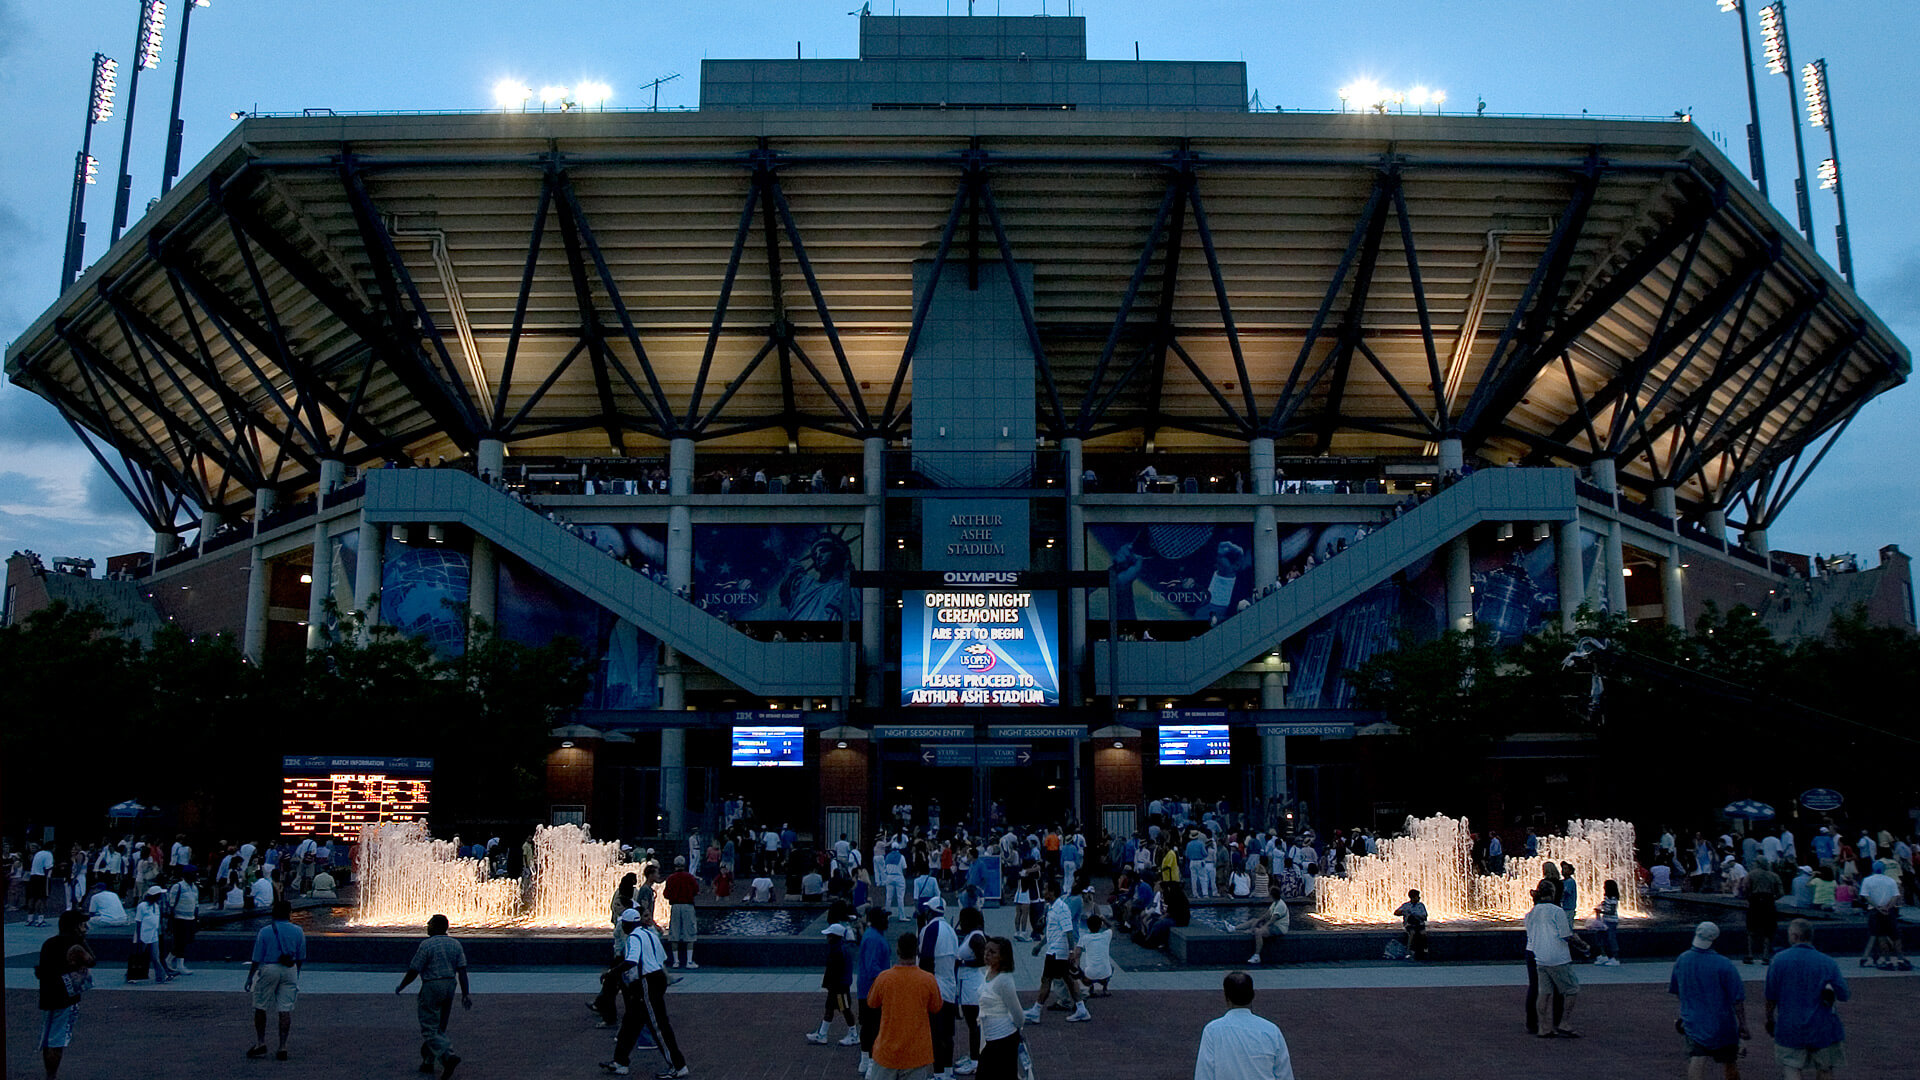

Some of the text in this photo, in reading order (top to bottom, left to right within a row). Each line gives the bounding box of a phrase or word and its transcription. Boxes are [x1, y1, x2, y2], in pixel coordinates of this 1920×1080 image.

[949, 514, 1003, 526] ARTHUR
[959, 529, 993, 540] ASHE
[947, 543, 1005, 555] STADIUM
[943, 572, 1018, 583] OLYMPUS
[705, 592, 759, 605] US OPEN
[925, 593, 1031, 608] OPENING NIGHT
[1151, 591, 1204, 603] US OPEN
[937, 608, 1019, 623] CEREMONIES
[932, 628, 1024, 640] ARE SET TO BEGIN
[960, 655, 991, 665] US OPEN
[921, 674, 1034, 688] PLEASE PROCEED TO
[911, 689, 1045, 704] ARTHUR ASHE STADIUM
[736, 712, 753, 720] IBM
[1161, 710, 1179, 719] IBM
[884, 728, 966, 737] NIGHT SESSION ENTRY
[998, 728, 1080, 737] NIGHT SESSION ENTRY
[1267, 726, 1347, 735] NIGHT SESSION ENTRY
